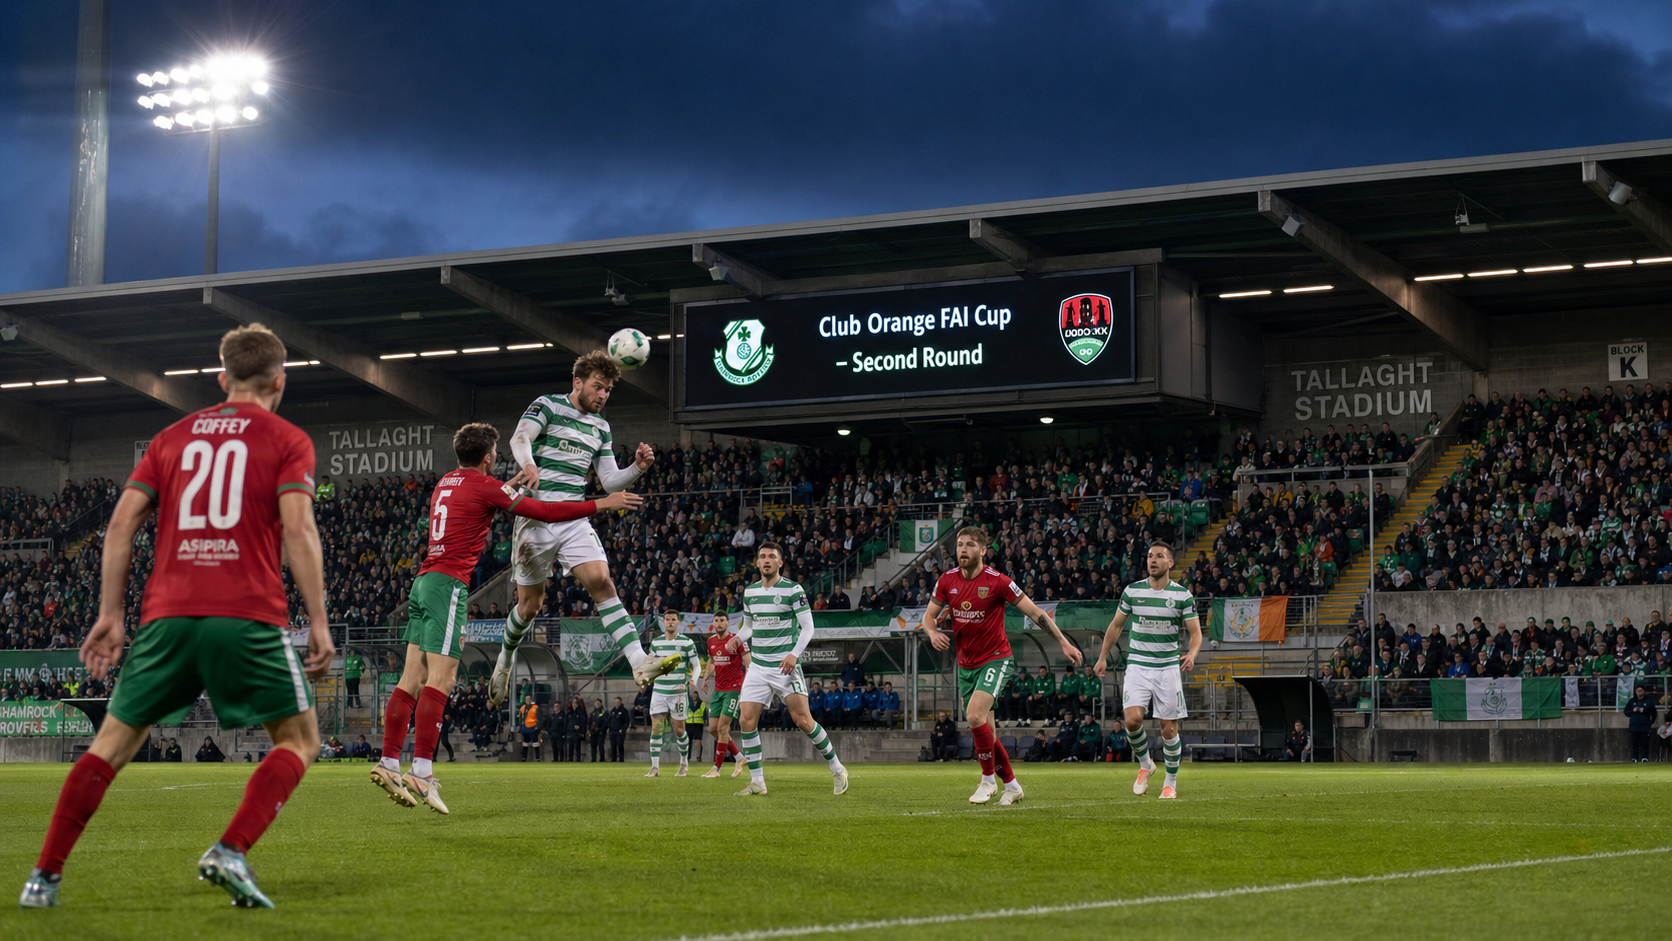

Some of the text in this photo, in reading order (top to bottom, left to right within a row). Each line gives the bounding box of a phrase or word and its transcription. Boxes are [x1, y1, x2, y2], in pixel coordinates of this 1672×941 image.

[819, 304, 1011, 338] Club Orange FAI Cup
[852, 347, 917, 372] Second
[923, 343, 982, 368] Round
[1611, 345, 1644, 355] BLOCK
[1291, 361, 1433, 391] TALLAGHT
[1620, 356, 1638, 378] K
[1295, 389, 1432, 421] STADIUM
[191, 418, 252, 434] COFFEY
[329, 425, 434, 450] TALLAGHT
[330, 449, 433, 475] STADIUM
[178, 439, 248, 530] 20
[432, 490, 452, 541] 5
[985, 668, 996, 682] 6
[0, 705, 57, 718] HAMROCK
